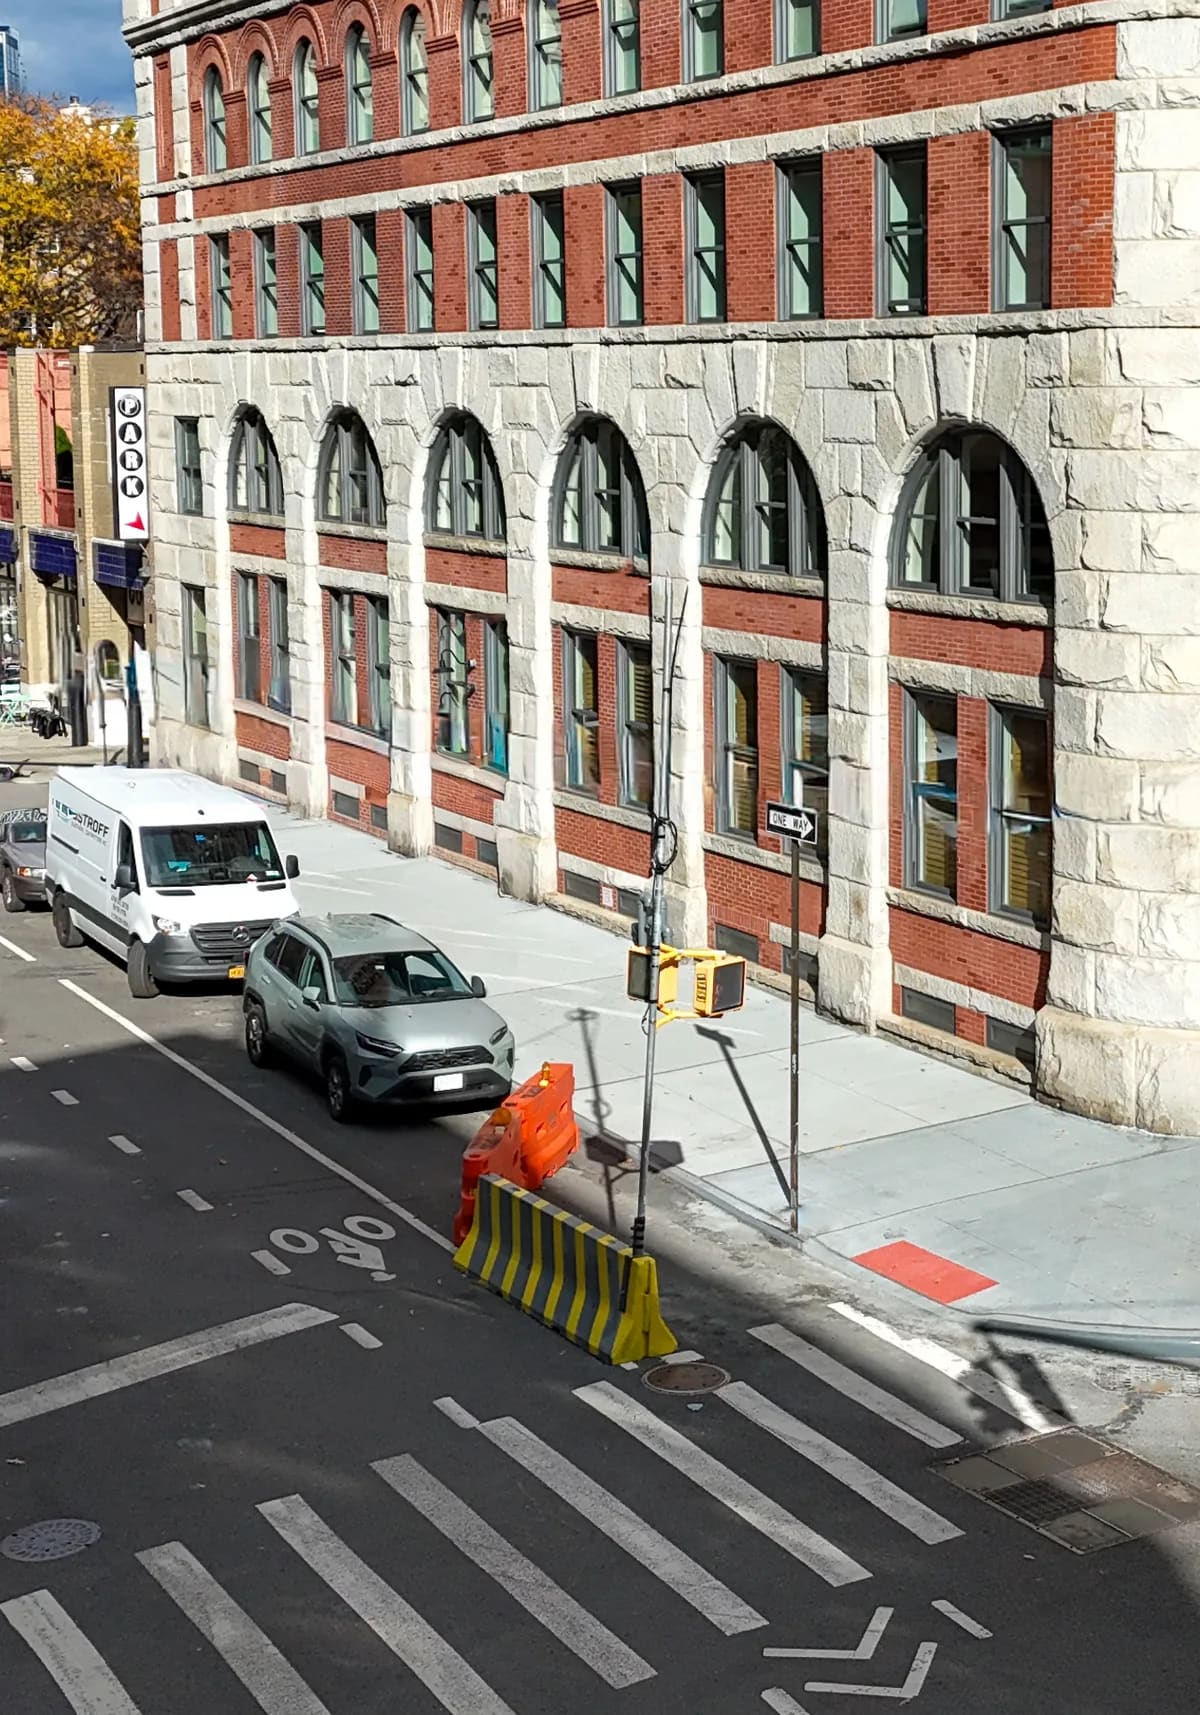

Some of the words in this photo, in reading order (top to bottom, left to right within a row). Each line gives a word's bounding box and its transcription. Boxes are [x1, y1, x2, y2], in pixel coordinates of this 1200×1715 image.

[119, 395, 143, 498] PARK
[772, 812, 787, 827] ONE
[792, 817, 808, 831] WAY
